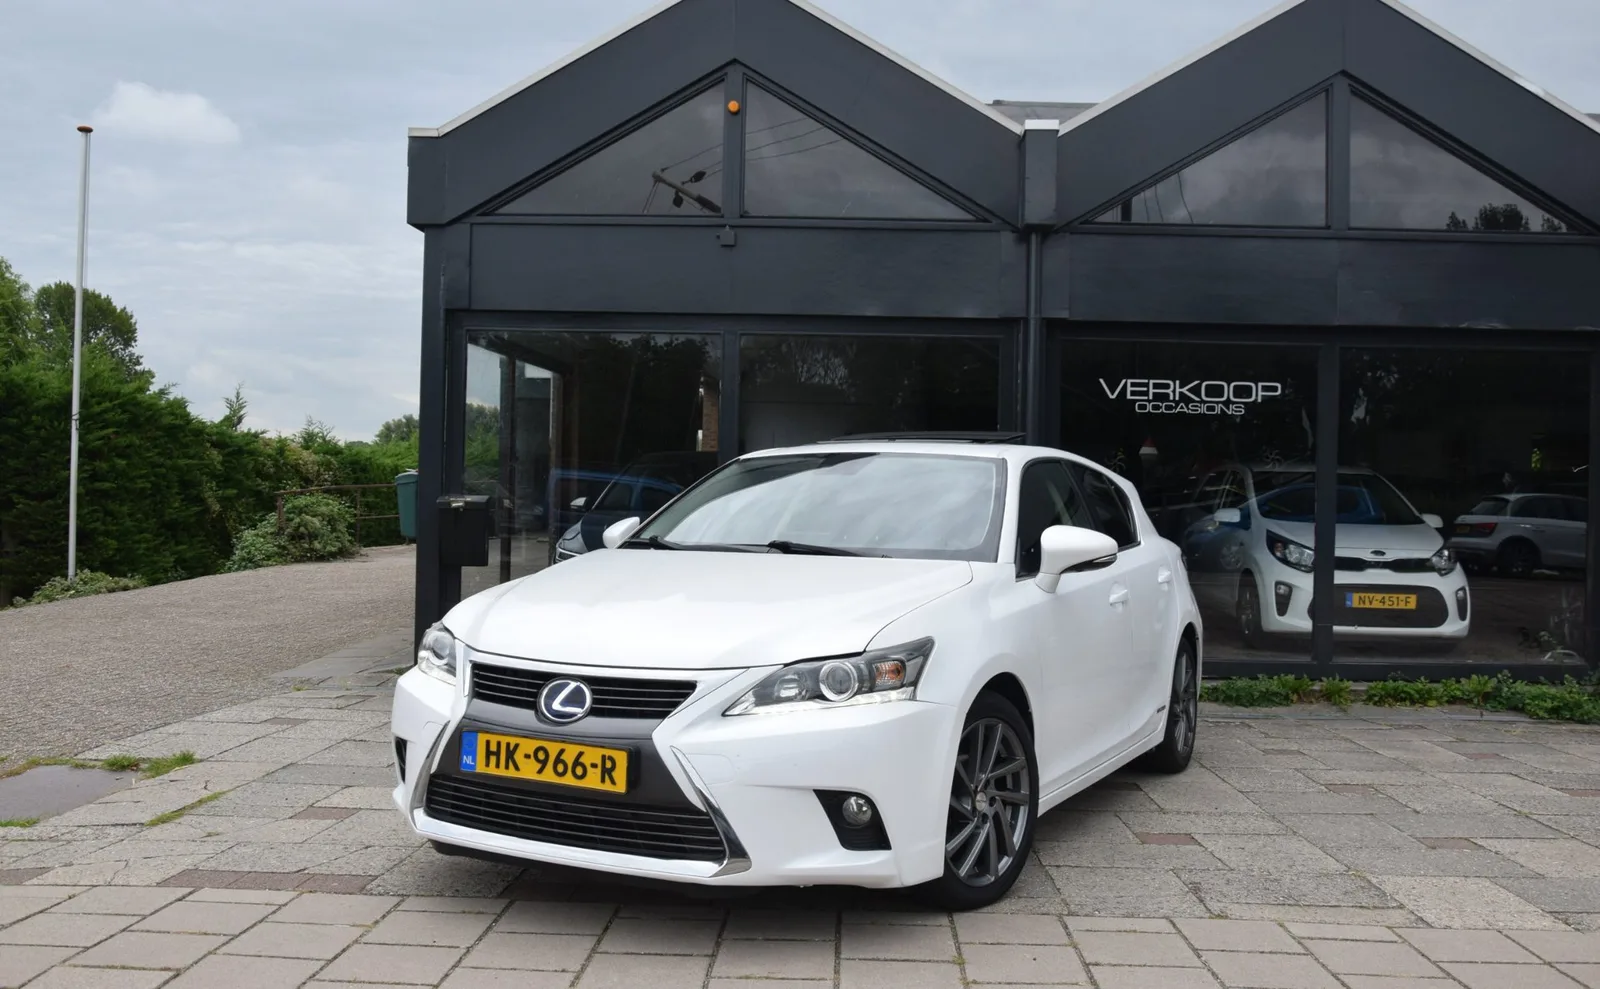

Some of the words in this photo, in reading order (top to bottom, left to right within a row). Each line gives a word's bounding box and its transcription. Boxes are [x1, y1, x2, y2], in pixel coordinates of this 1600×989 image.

[1098, 378, 1282, 403] VERKOOP
[1135, 401, 1246, 415] OCCASIONS
[1358, 595, 1412, 607] NV-451-F
[462, 755, 475, 765] NL
[484, 739, 618, 786] HK-966-R
